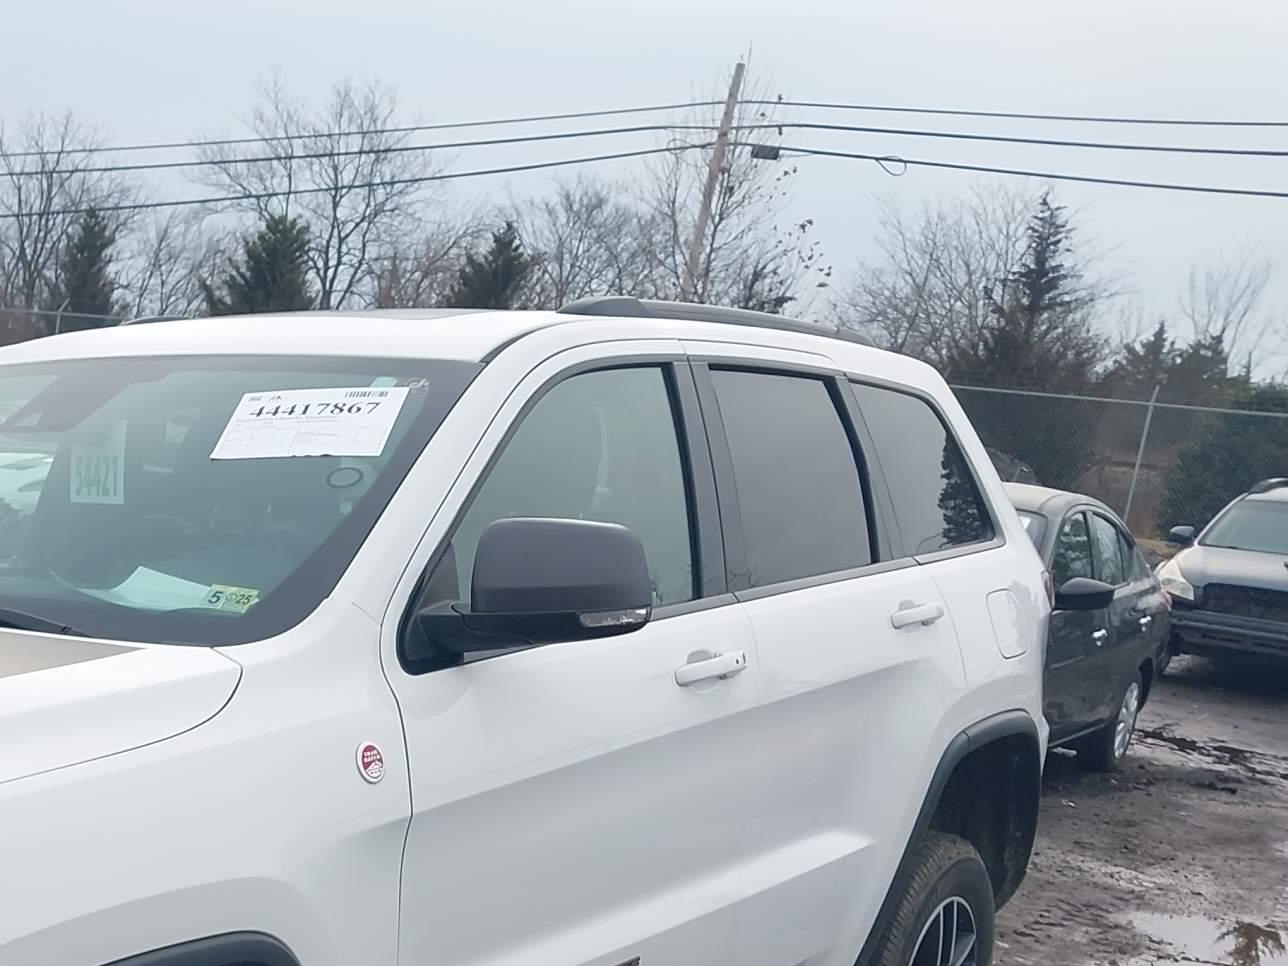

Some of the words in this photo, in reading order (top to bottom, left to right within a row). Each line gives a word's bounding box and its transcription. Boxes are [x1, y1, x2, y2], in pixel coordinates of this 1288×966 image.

[249, 402, 380, 417] 44417867
[208, 591, 224, 604] 5
[236, 594, 252, 605] 25
